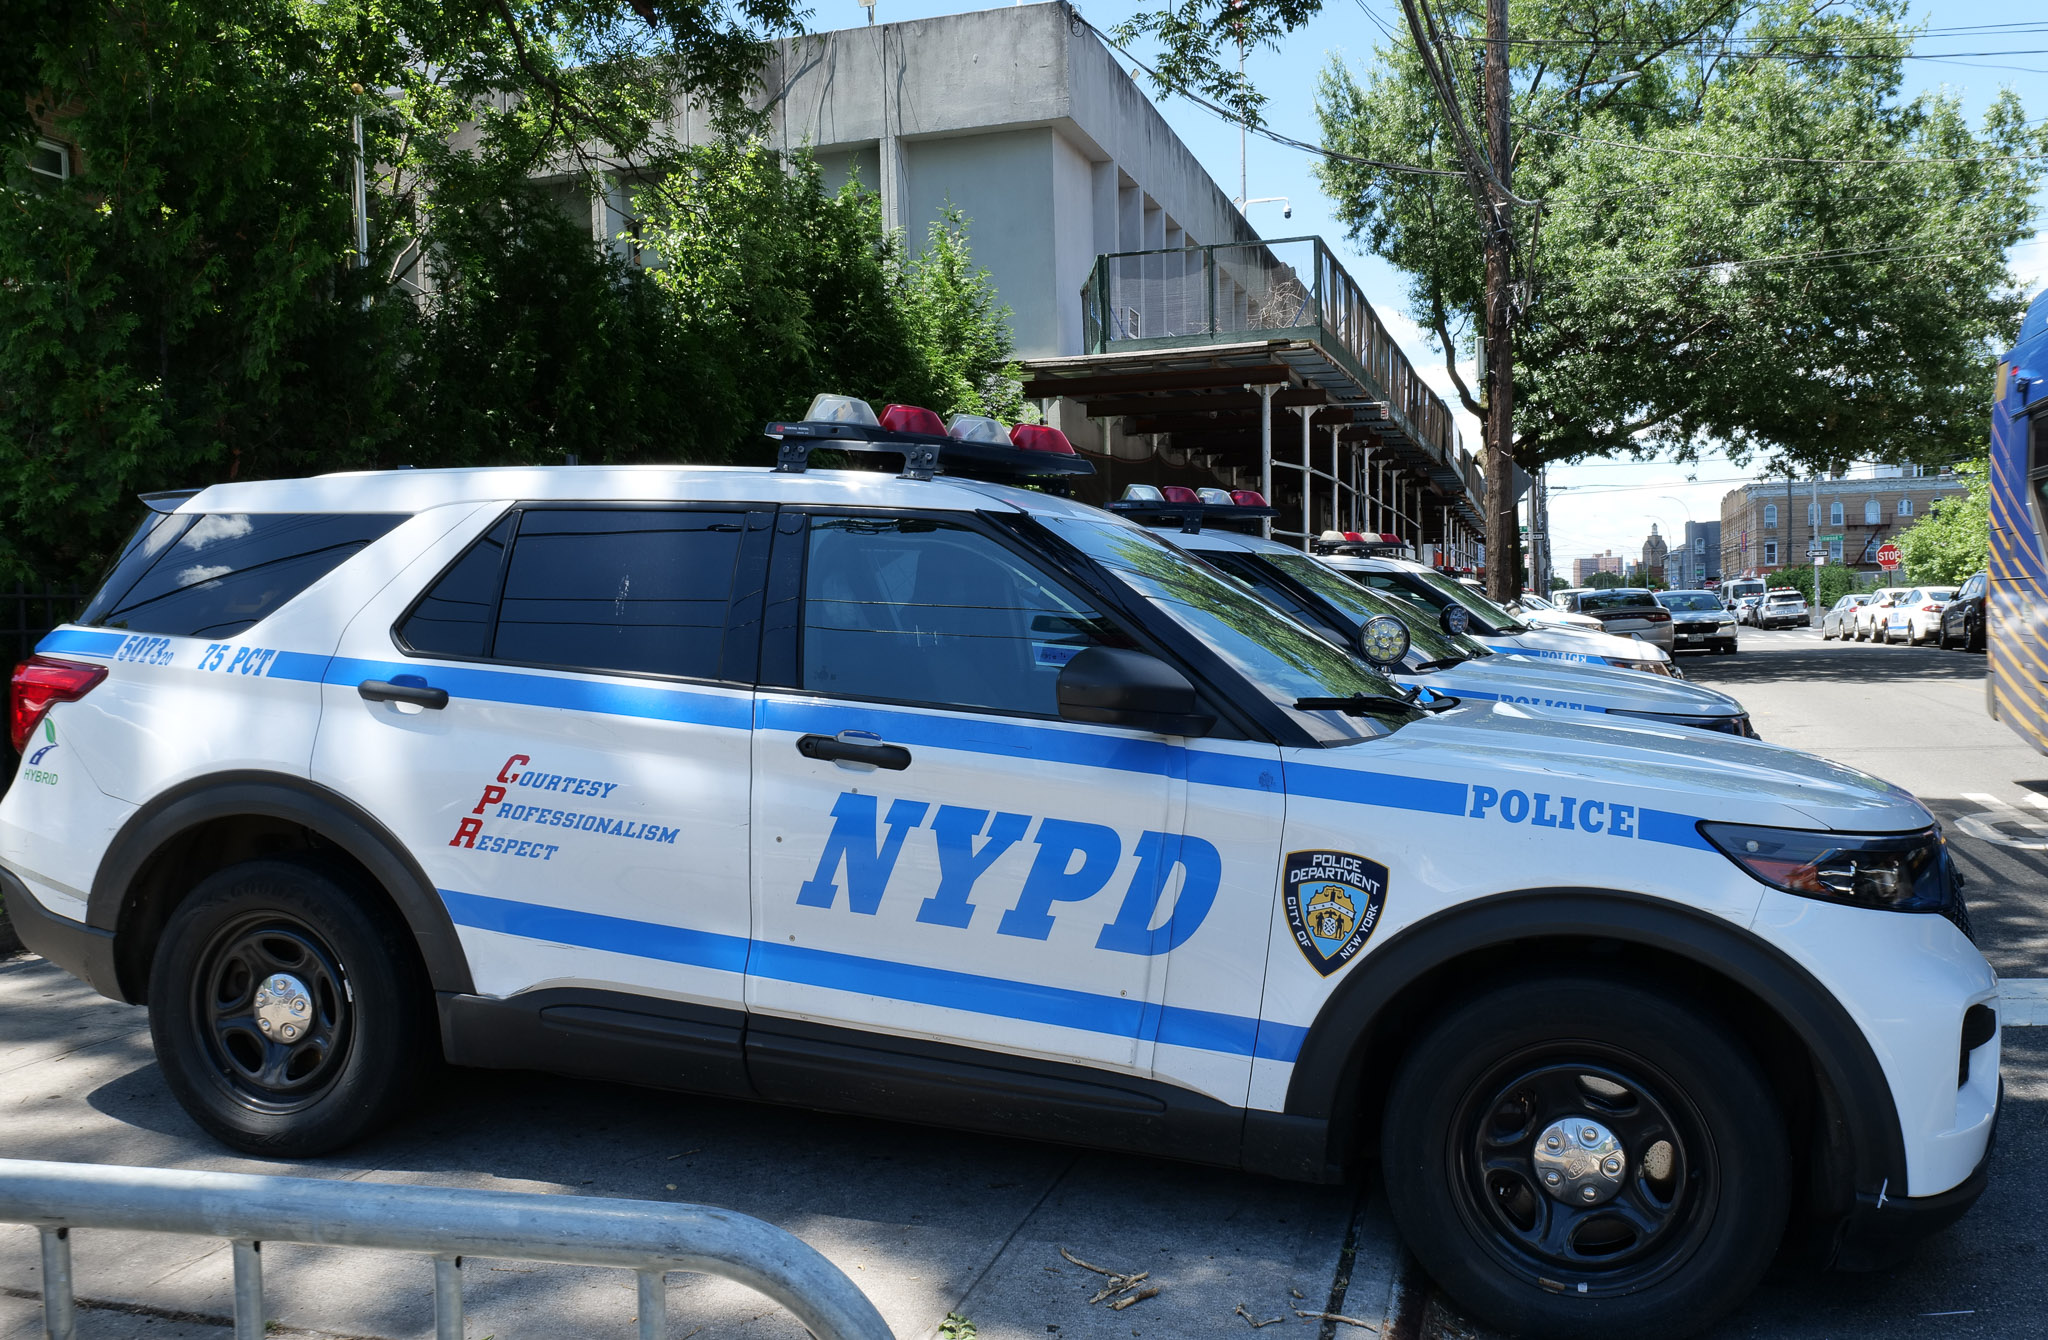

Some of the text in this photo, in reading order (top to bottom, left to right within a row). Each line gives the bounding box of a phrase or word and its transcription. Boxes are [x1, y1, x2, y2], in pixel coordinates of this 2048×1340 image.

[1878, 550, 1900, 561] STOP
[118, 635, 171, 665] 5073
[198, 643, 231, 672] 75
[227, 646, 277, 676] PCT
[23, 768, 59, 786] HYBRID
[496, 753, 618, 799] COURTESY
[472, 784, 681, 844] PROFESSIONALISM
[1469, 784, 1635, 838] POLICE
[448, 817, 559, 861] RESPECT
[795, 791, 1222, 957] NYPD
[1290, 867, 1380, 895] DEPARTMENT
[1312, 854, 1362, 873] POLICE
[1287, 896, 1312, 948] CITY OF
[1339, 903, 1379, 960] NEW YORK
